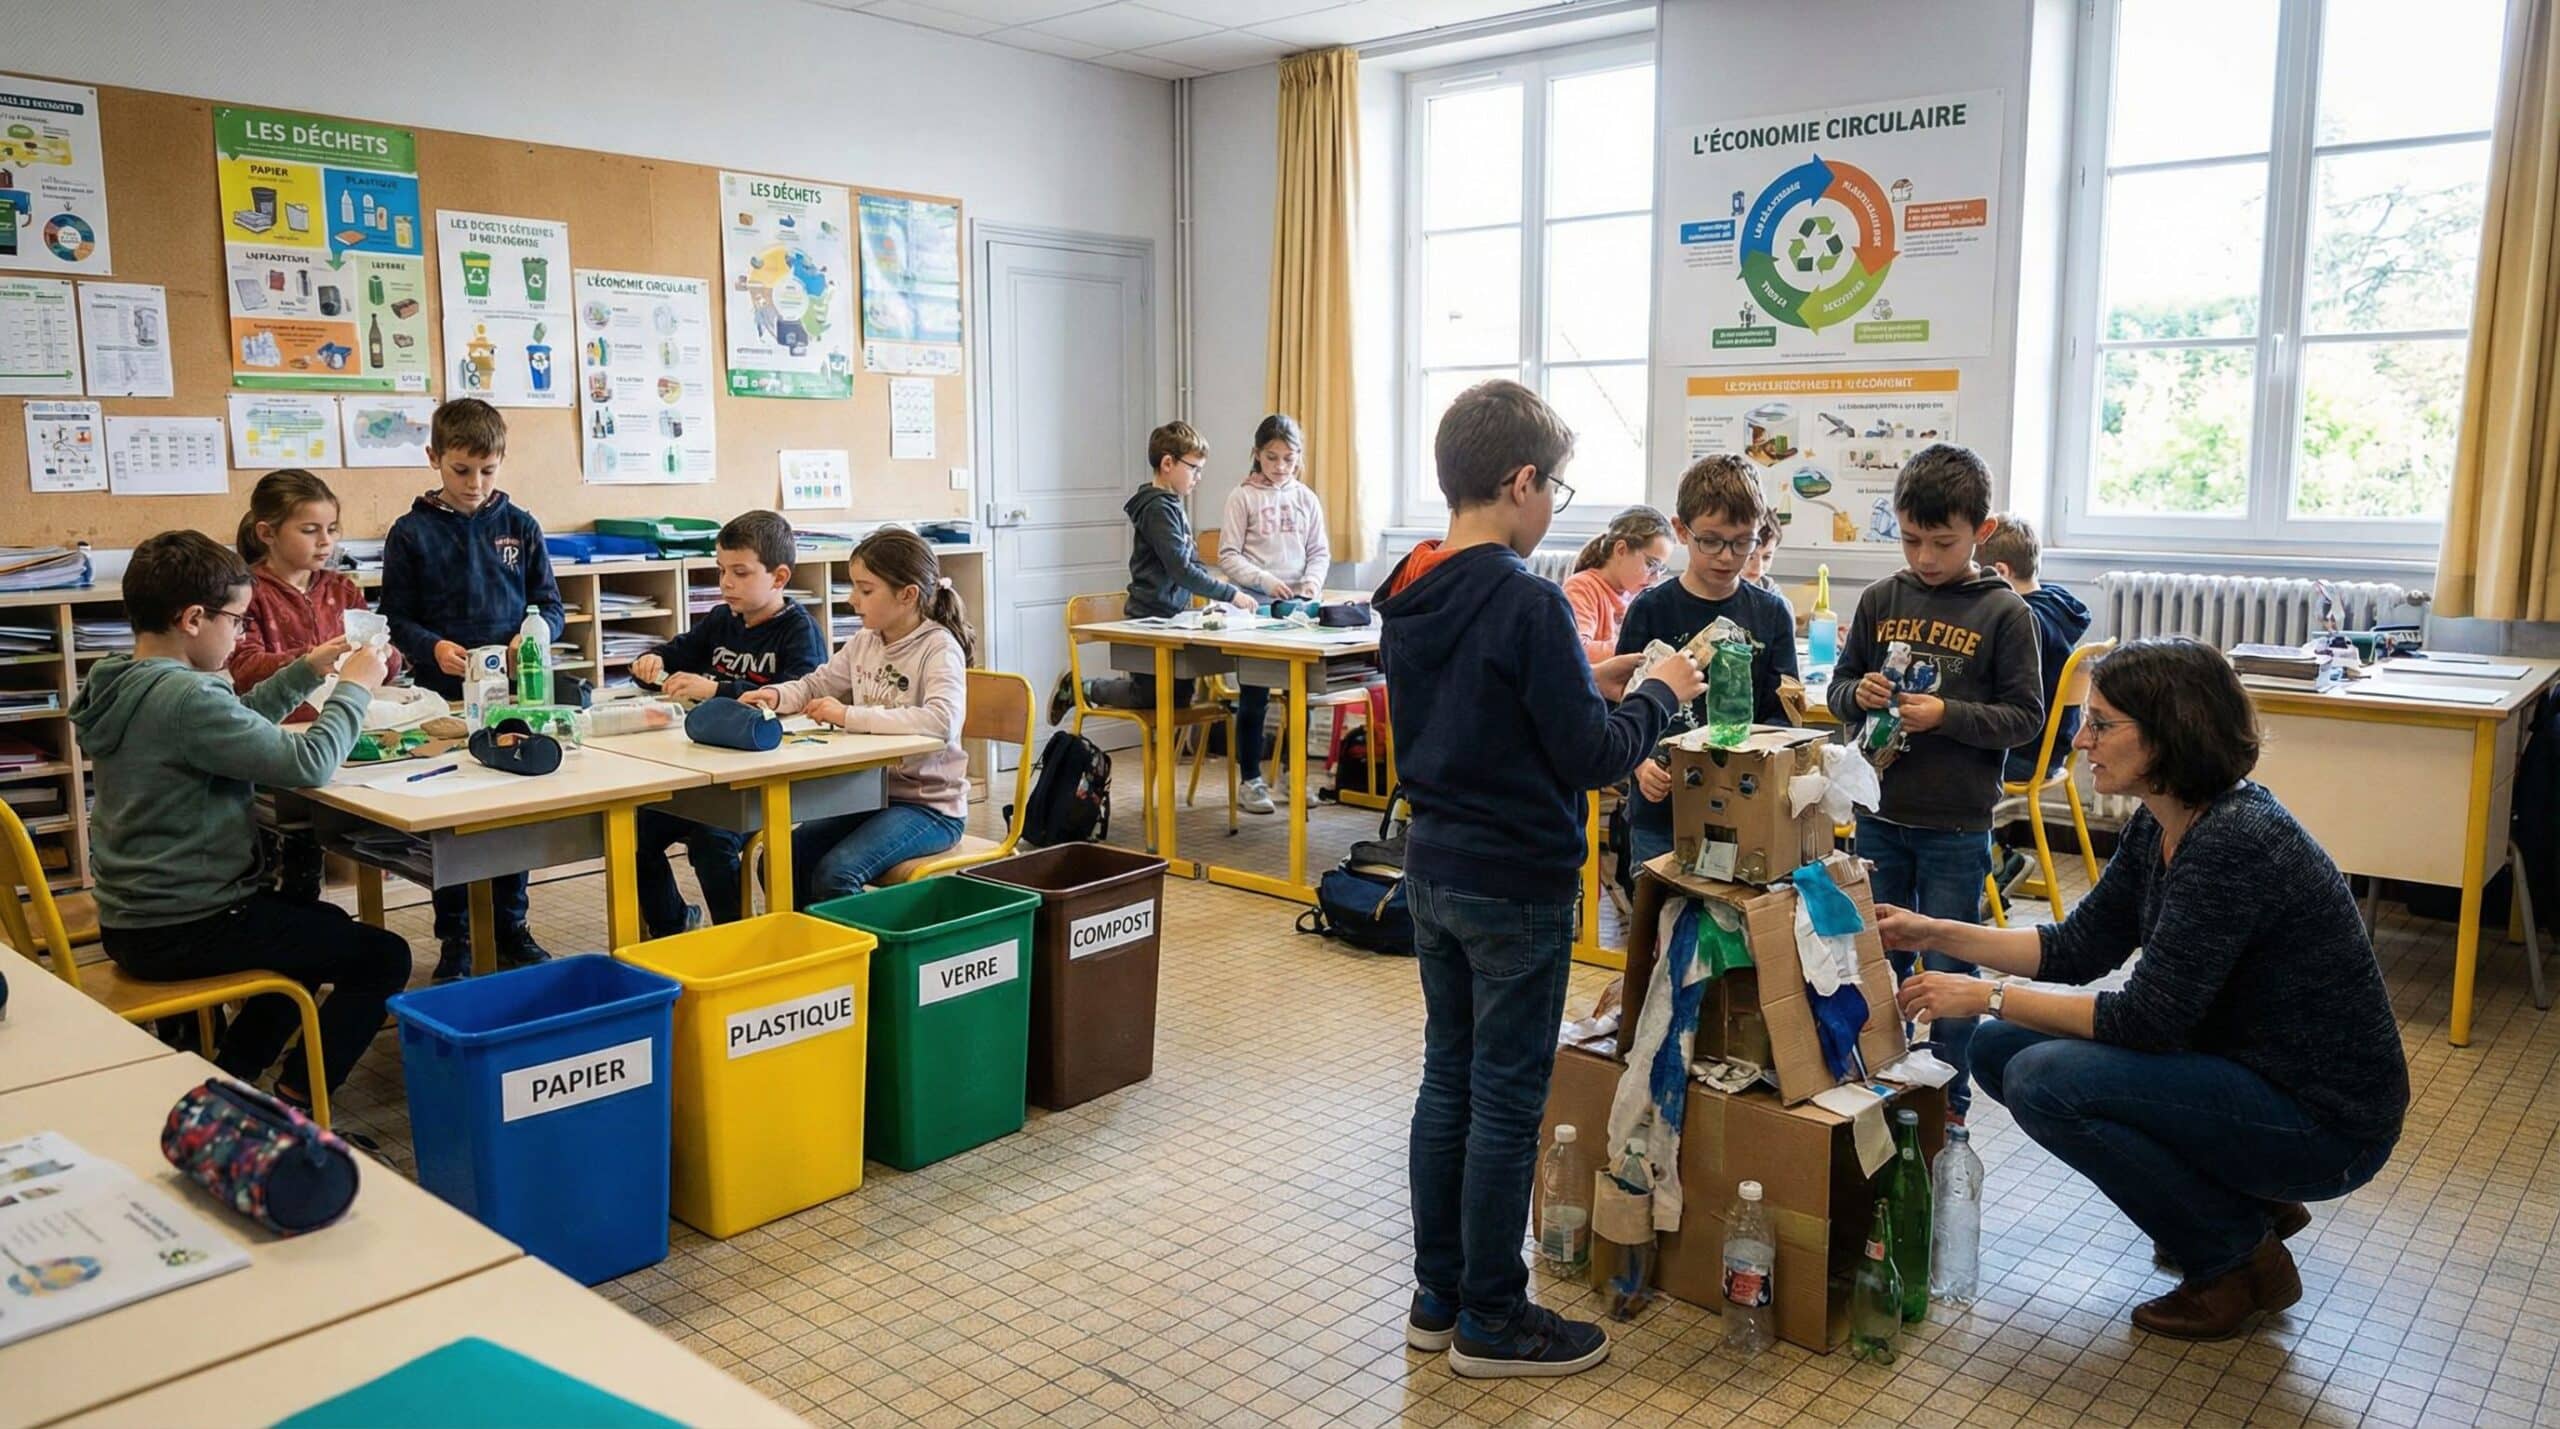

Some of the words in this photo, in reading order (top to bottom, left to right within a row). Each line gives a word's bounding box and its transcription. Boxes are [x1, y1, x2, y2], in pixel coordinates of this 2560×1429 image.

[245, 120, 286, 142] LES
[293, 123, 389, 155] DÉCHETS
[1693, 121, 1820, 155] L'ÉCONOMIE
[1826, 103, 1967, 140] CIRCULAIRE
[250, 165, 289, 177] PAPIER
[750, 182, 770, 198] LES
[773, 182, 822, 205] DÉCHETS
[1927, 620, 1982, 656] FIGE
[1073, 910, 1151, 948] COMPOST
[940, 956, 998, 989] VERRE
[730, 996, 852, 1048] PLASTIQUE
[532, 1058, 626, 1103] PAPIER
